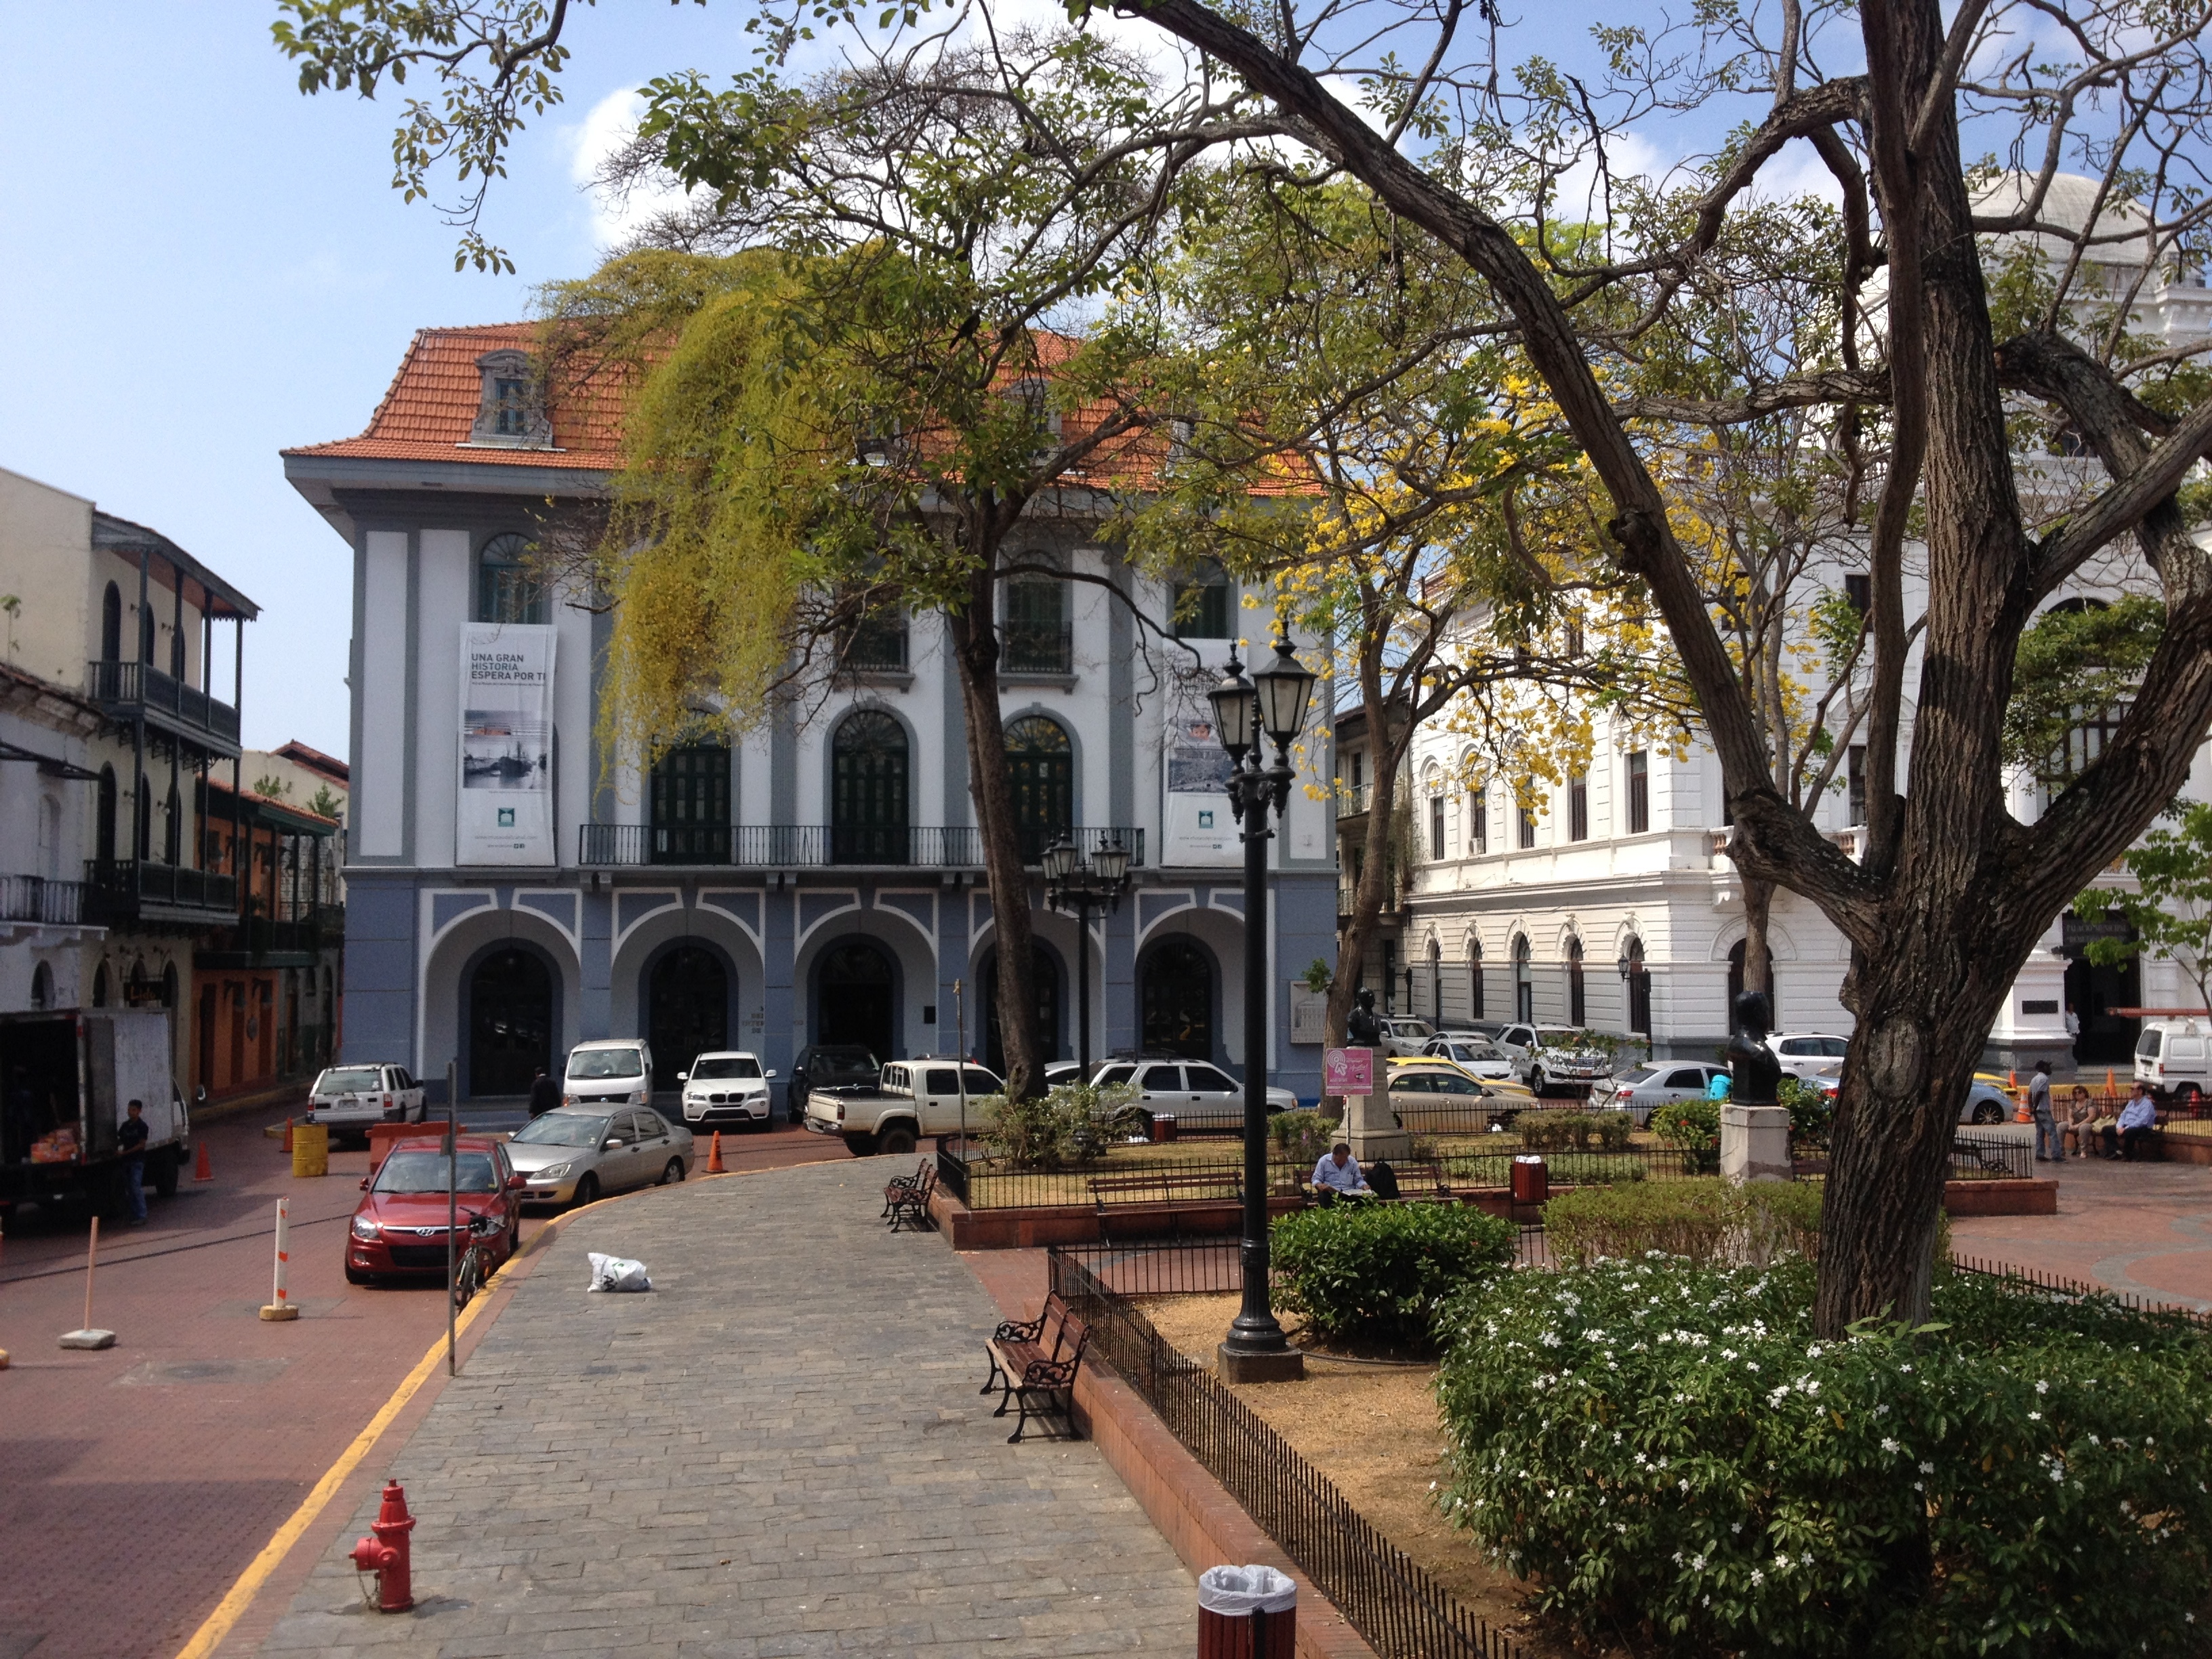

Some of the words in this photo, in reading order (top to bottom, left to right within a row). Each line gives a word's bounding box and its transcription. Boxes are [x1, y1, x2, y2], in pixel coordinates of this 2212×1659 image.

[472, 653, 493, 661] UNA
[496, 653, 524, 662] GRAN
[472, 662, 518, 671] HISTORIA
[472, 671, 511, 680] ESPERA
[514, 672, 534, 680] POR
[537, 672, 546, 680] TI
